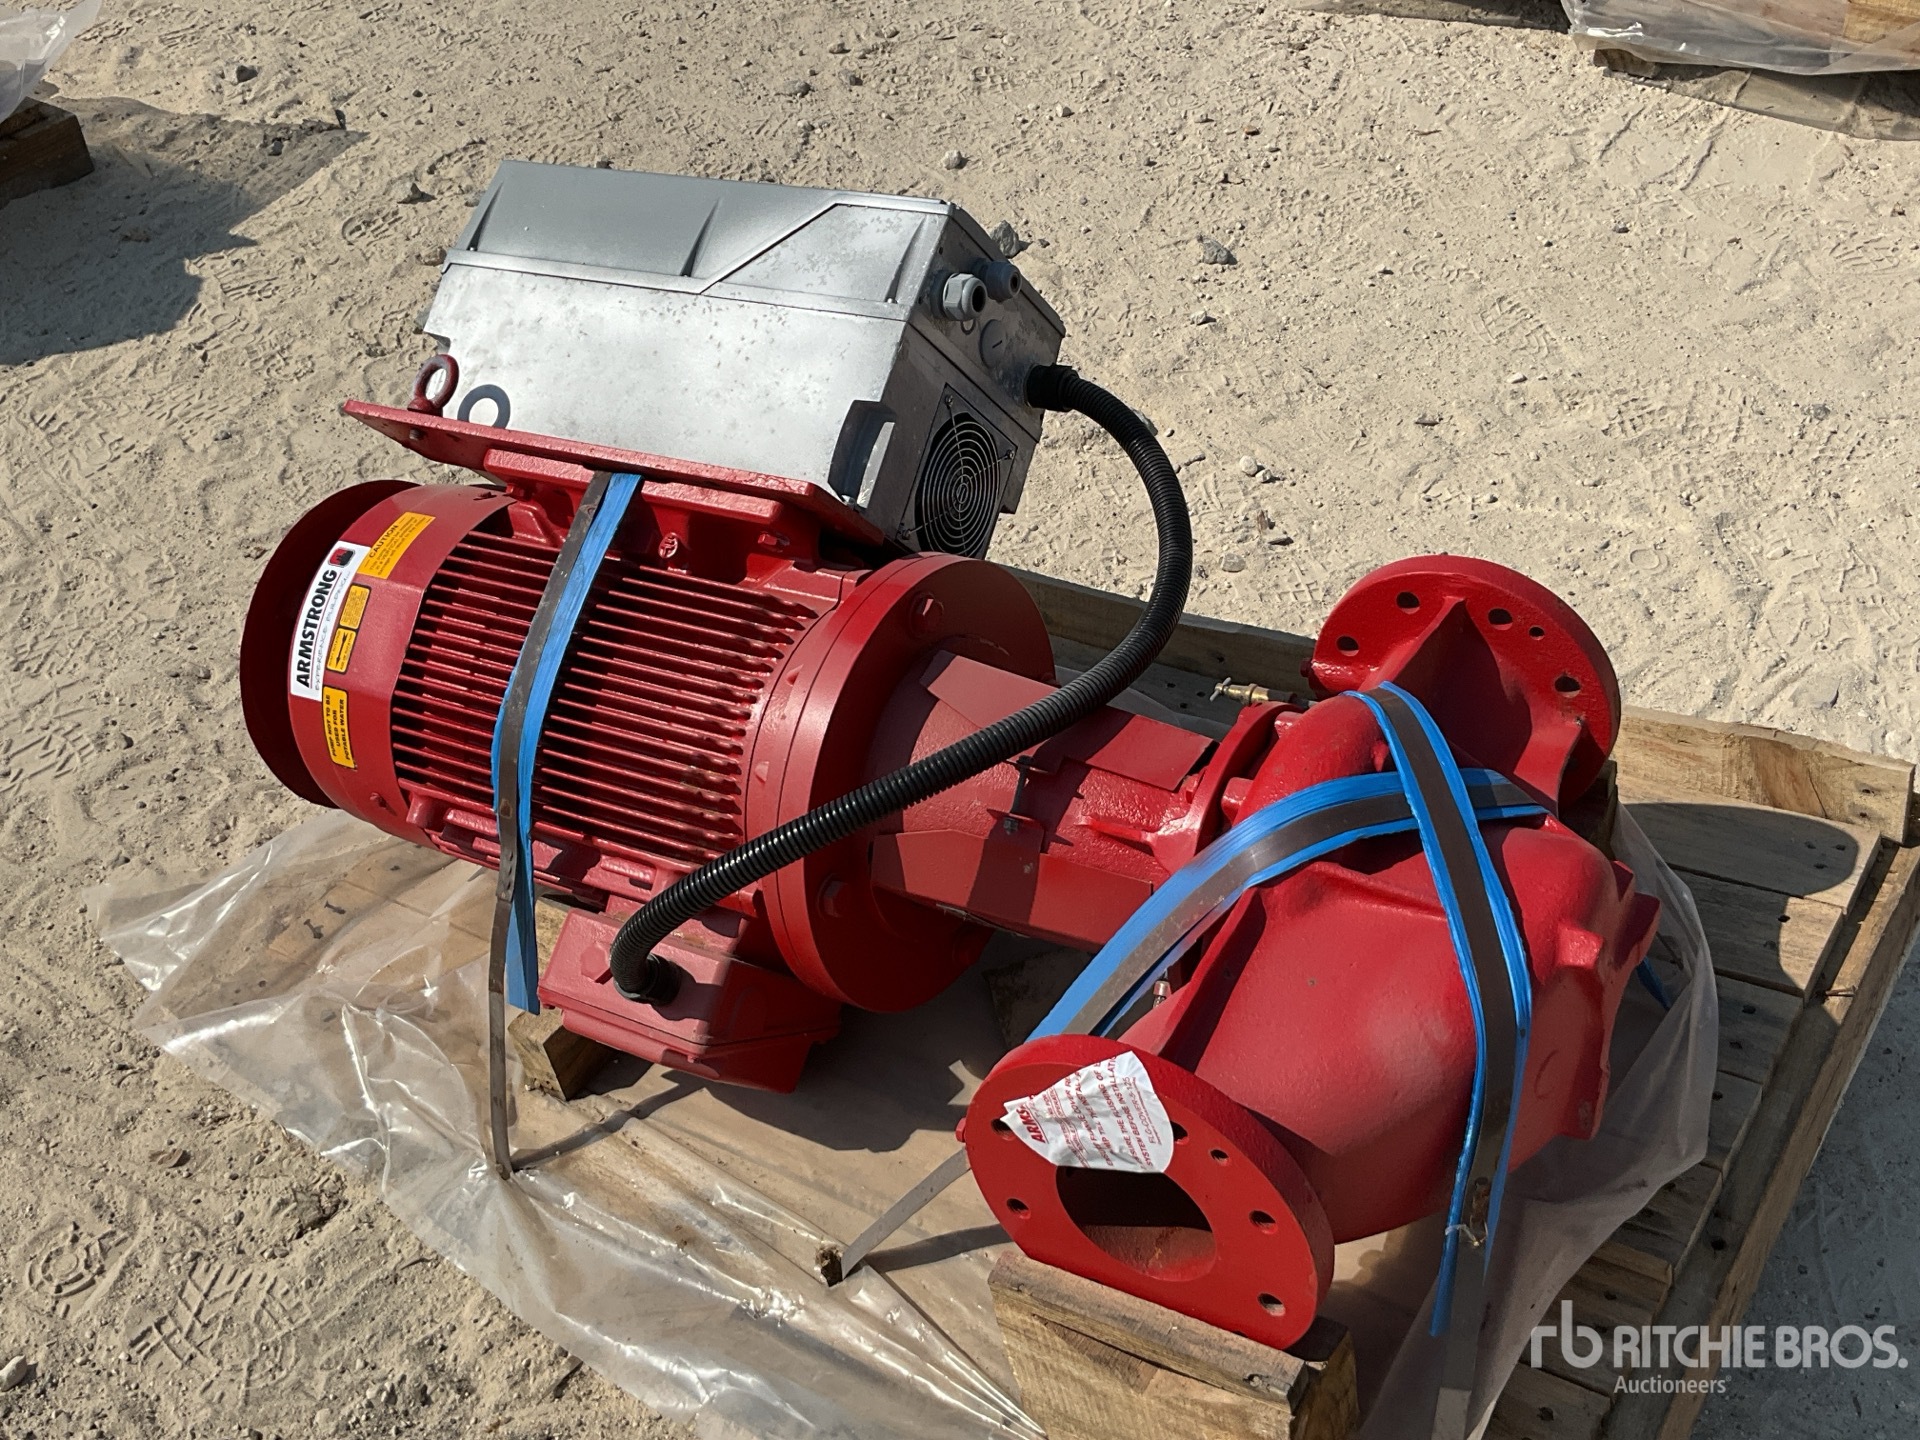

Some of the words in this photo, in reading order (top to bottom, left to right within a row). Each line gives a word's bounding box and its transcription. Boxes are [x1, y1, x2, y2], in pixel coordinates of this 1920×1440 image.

[369, 525, 399, 558] CAUTION
[296, 570, 337, 688] ARMSTRONG
[326, 695, 330, 705] BE
[326, 707, 330, 717] TO
[329, 737, 337, 756] PUMP
[341, 728, 350, 760] POTABLE
[1094, 1070, 1103, 1080] OF
[1065, 1090, 1081, 1114] COVER
[1098, 1084, 1121, 1118] FLUSHING
[1116, 1119, 1128, 1134] THE
[1122, 1105, 1140, 1136] BEFORE
[1136, 1136, 1153, 1167] SYSTEM
